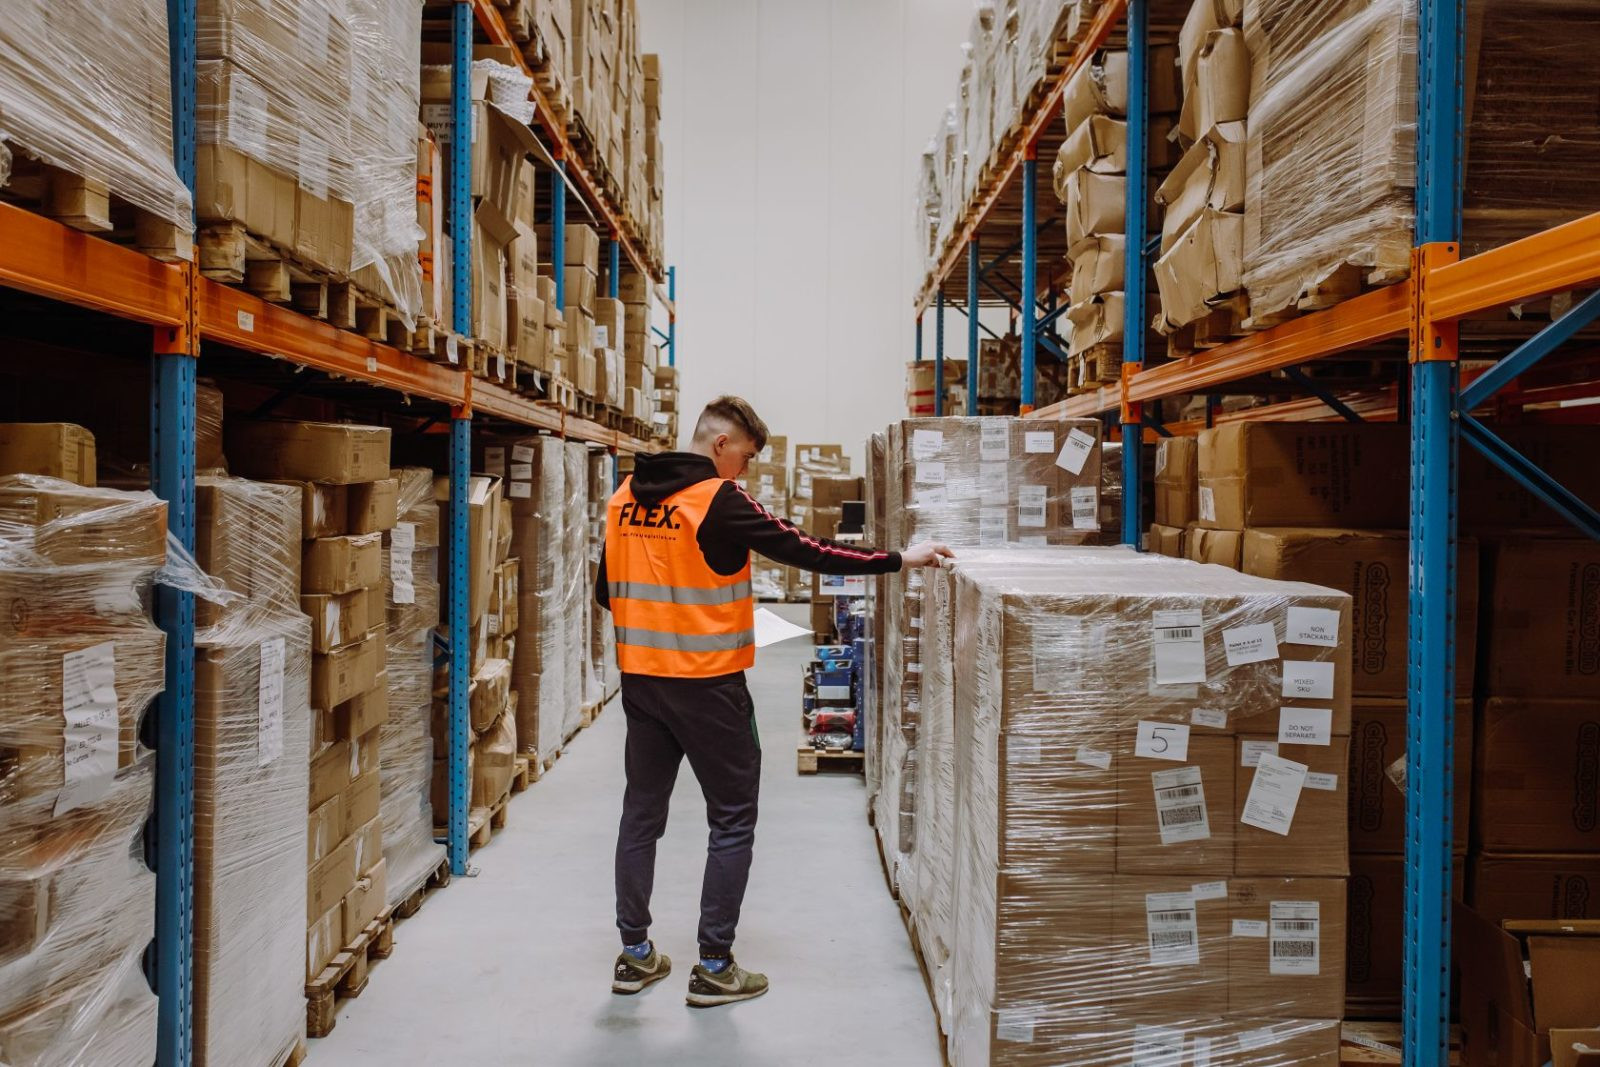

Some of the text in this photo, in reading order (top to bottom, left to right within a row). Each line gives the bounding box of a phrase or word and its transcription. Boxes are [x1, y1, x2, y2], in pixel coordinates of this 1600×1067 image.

[618, 502, 680, 529] FLEX.
[1310, 626, 1326, 634] NON
[1298, 632, 1336, 642] STACKABLE
[1294, 678, 1314, 686] MIXED
[1150, 728, 1176, 753] 5
[1284, 732, 1316, 740] SEPARATE
